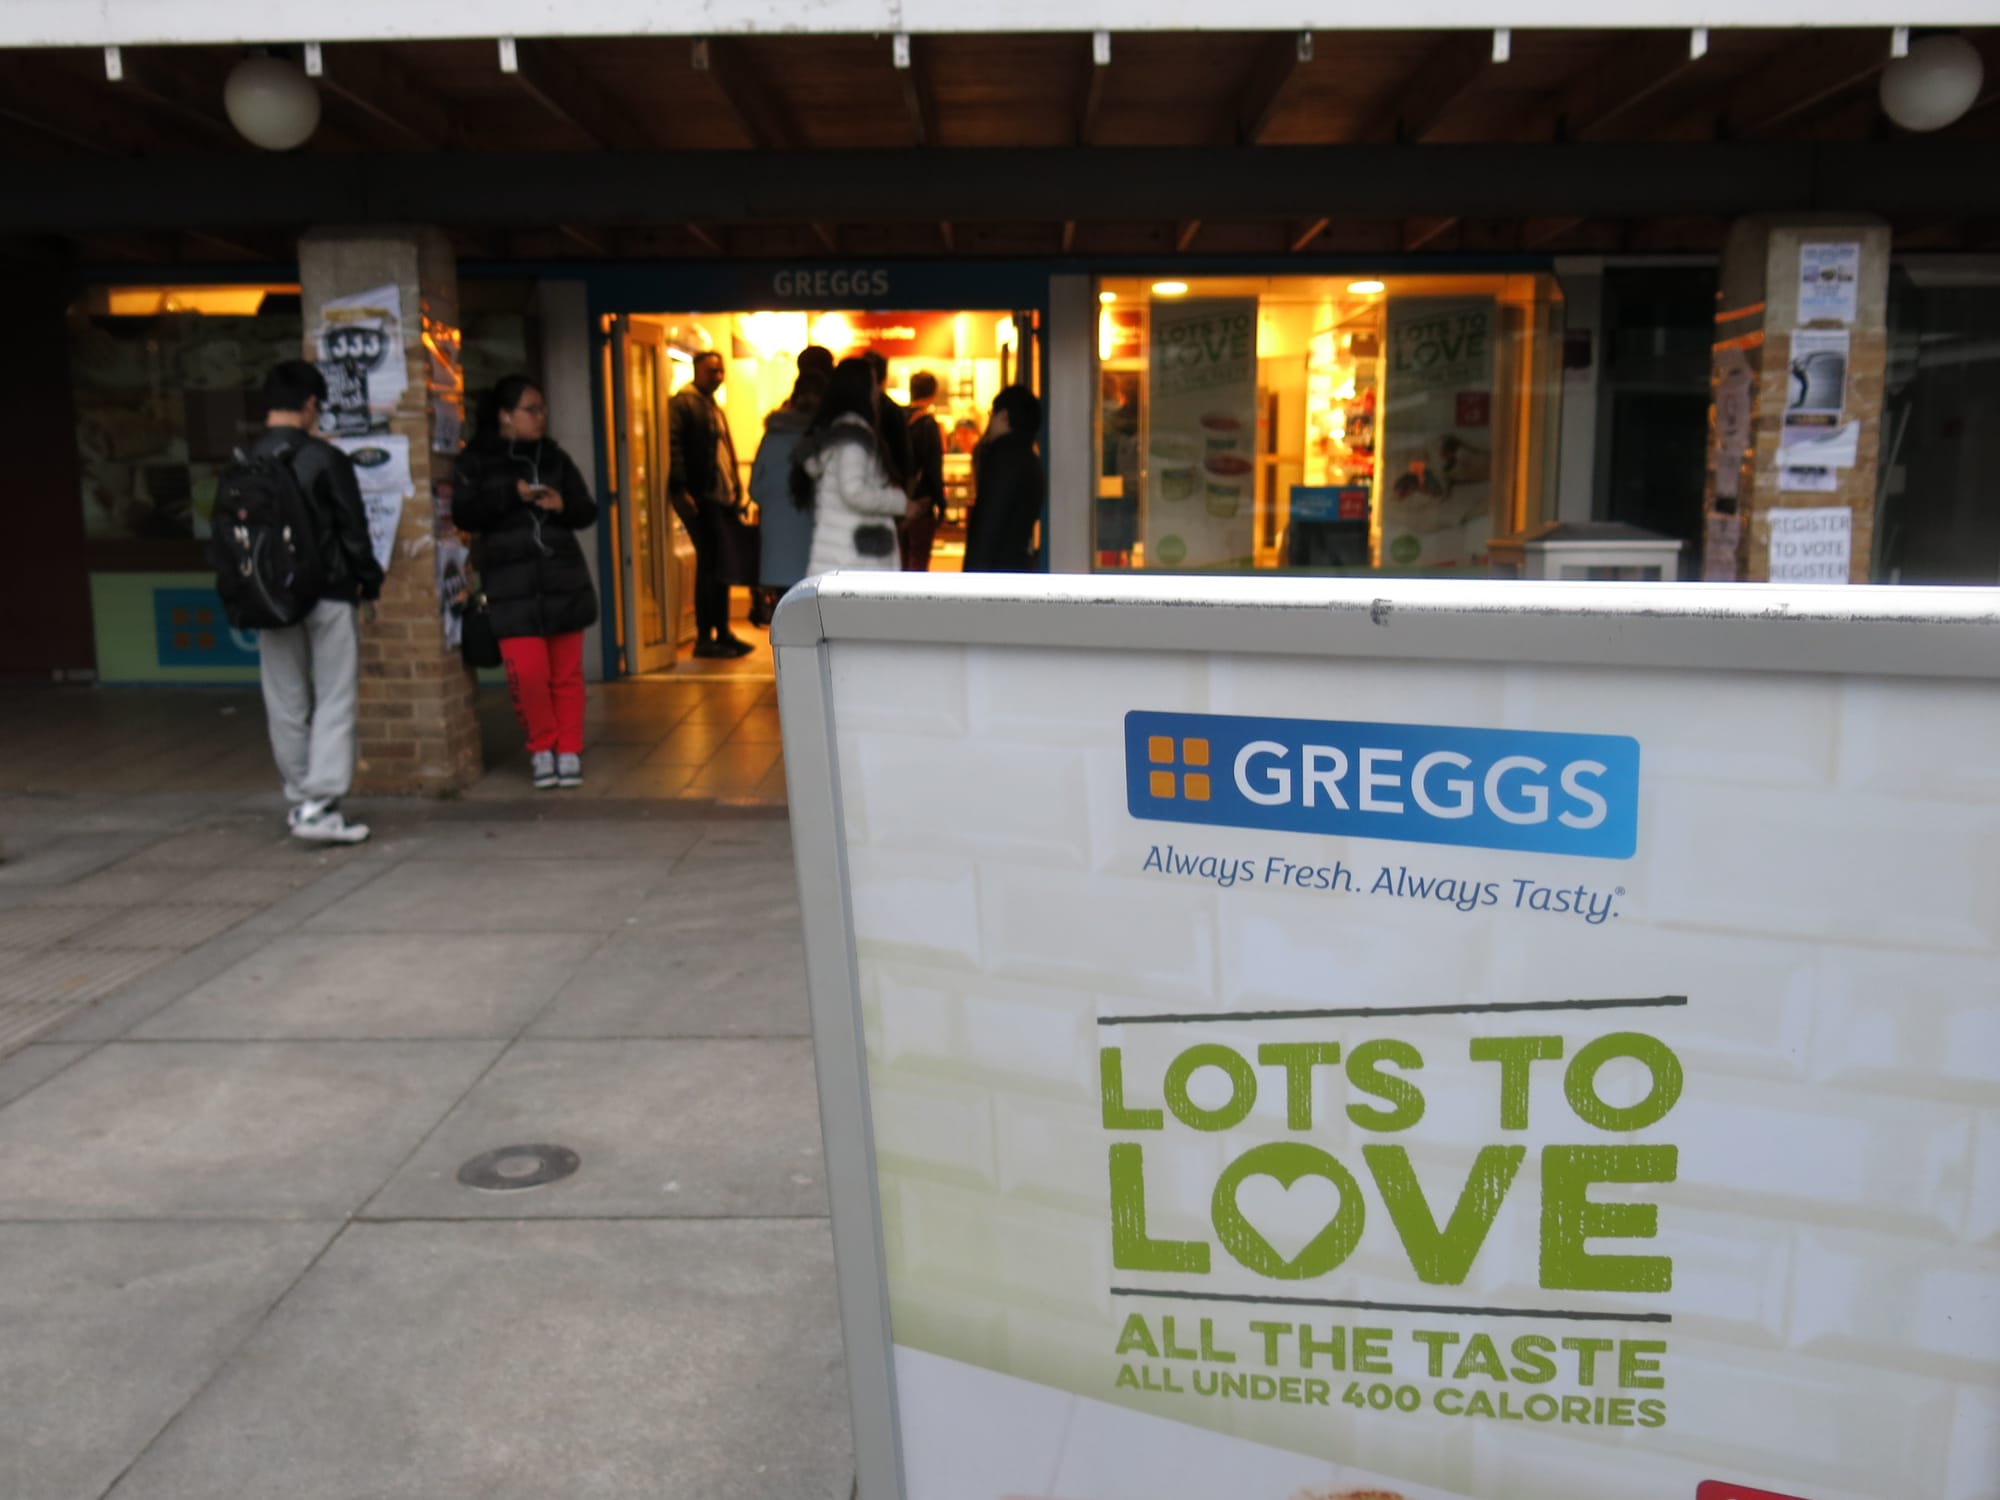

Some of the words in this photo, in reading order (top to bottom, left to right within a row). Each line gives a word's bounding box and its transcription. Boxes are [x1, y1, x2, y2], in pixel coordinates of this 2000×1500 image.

[773, 269, 889, 297] GREGGS
[1775, 542, 1797, 558] TO
[1801, 541, 1844, 557] VOTE
[1232, 740, 1608, 830] GREGGS
[1142, 846, 1255, 887] Always
[1264, 856, 1362, 892] Fresh.
[1371, 866, 1499, 912] Always
[1101, 1038, 1426, 1132] LOTS
[1470, 1032, 1684, 1132] TO
[1109, 1142, 1679, 1292] LOVE
[1115, 1313, 1236, 1363] ALL
[1250, 1321, 1393, 1374] THE
[1412, 1330, 1668, 1390] TASTE
[1115, 1367, 1184, 1394] ALL
[1192, 1372, 1331, 1406] UNDER
[1341, 1382, 1421, 1412] 400
[1432, 1388, 1668, 1429] CALORIES
